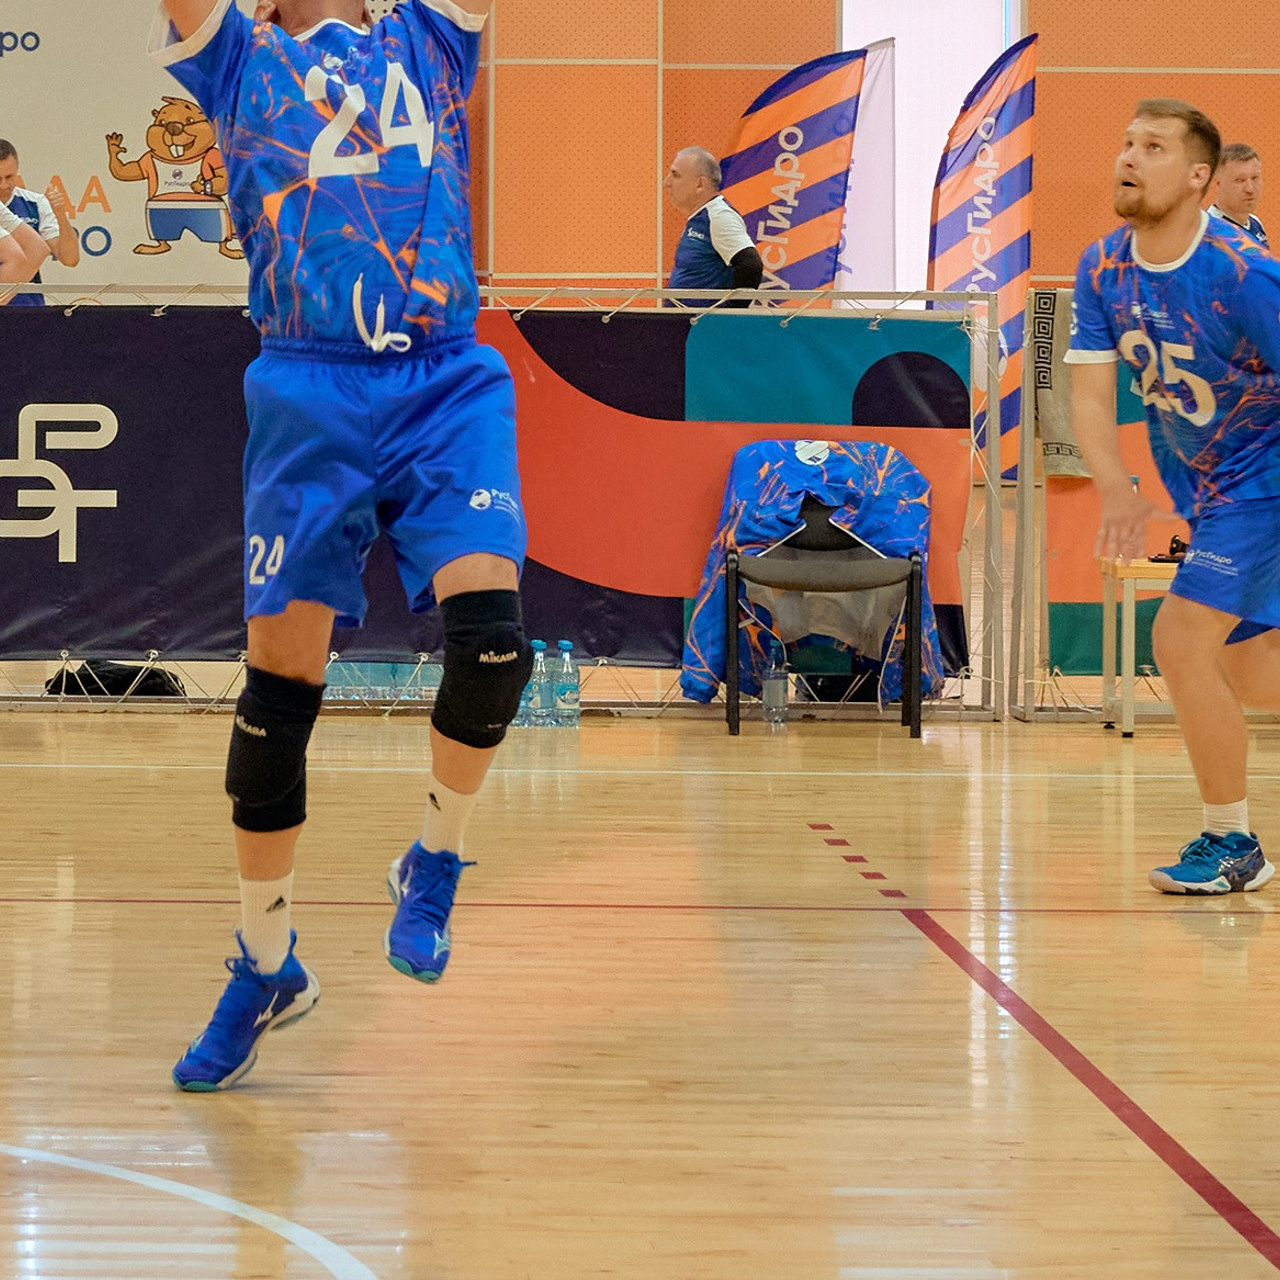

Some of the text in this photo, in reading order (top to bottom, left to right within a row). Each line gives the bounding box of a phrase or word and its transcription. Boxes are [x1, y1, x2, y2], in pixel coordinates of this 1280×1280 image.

[305, 60, 434, 179] 24
[1119, 330, 1216, 427] 25
[249, 535, 285, 585] 24
